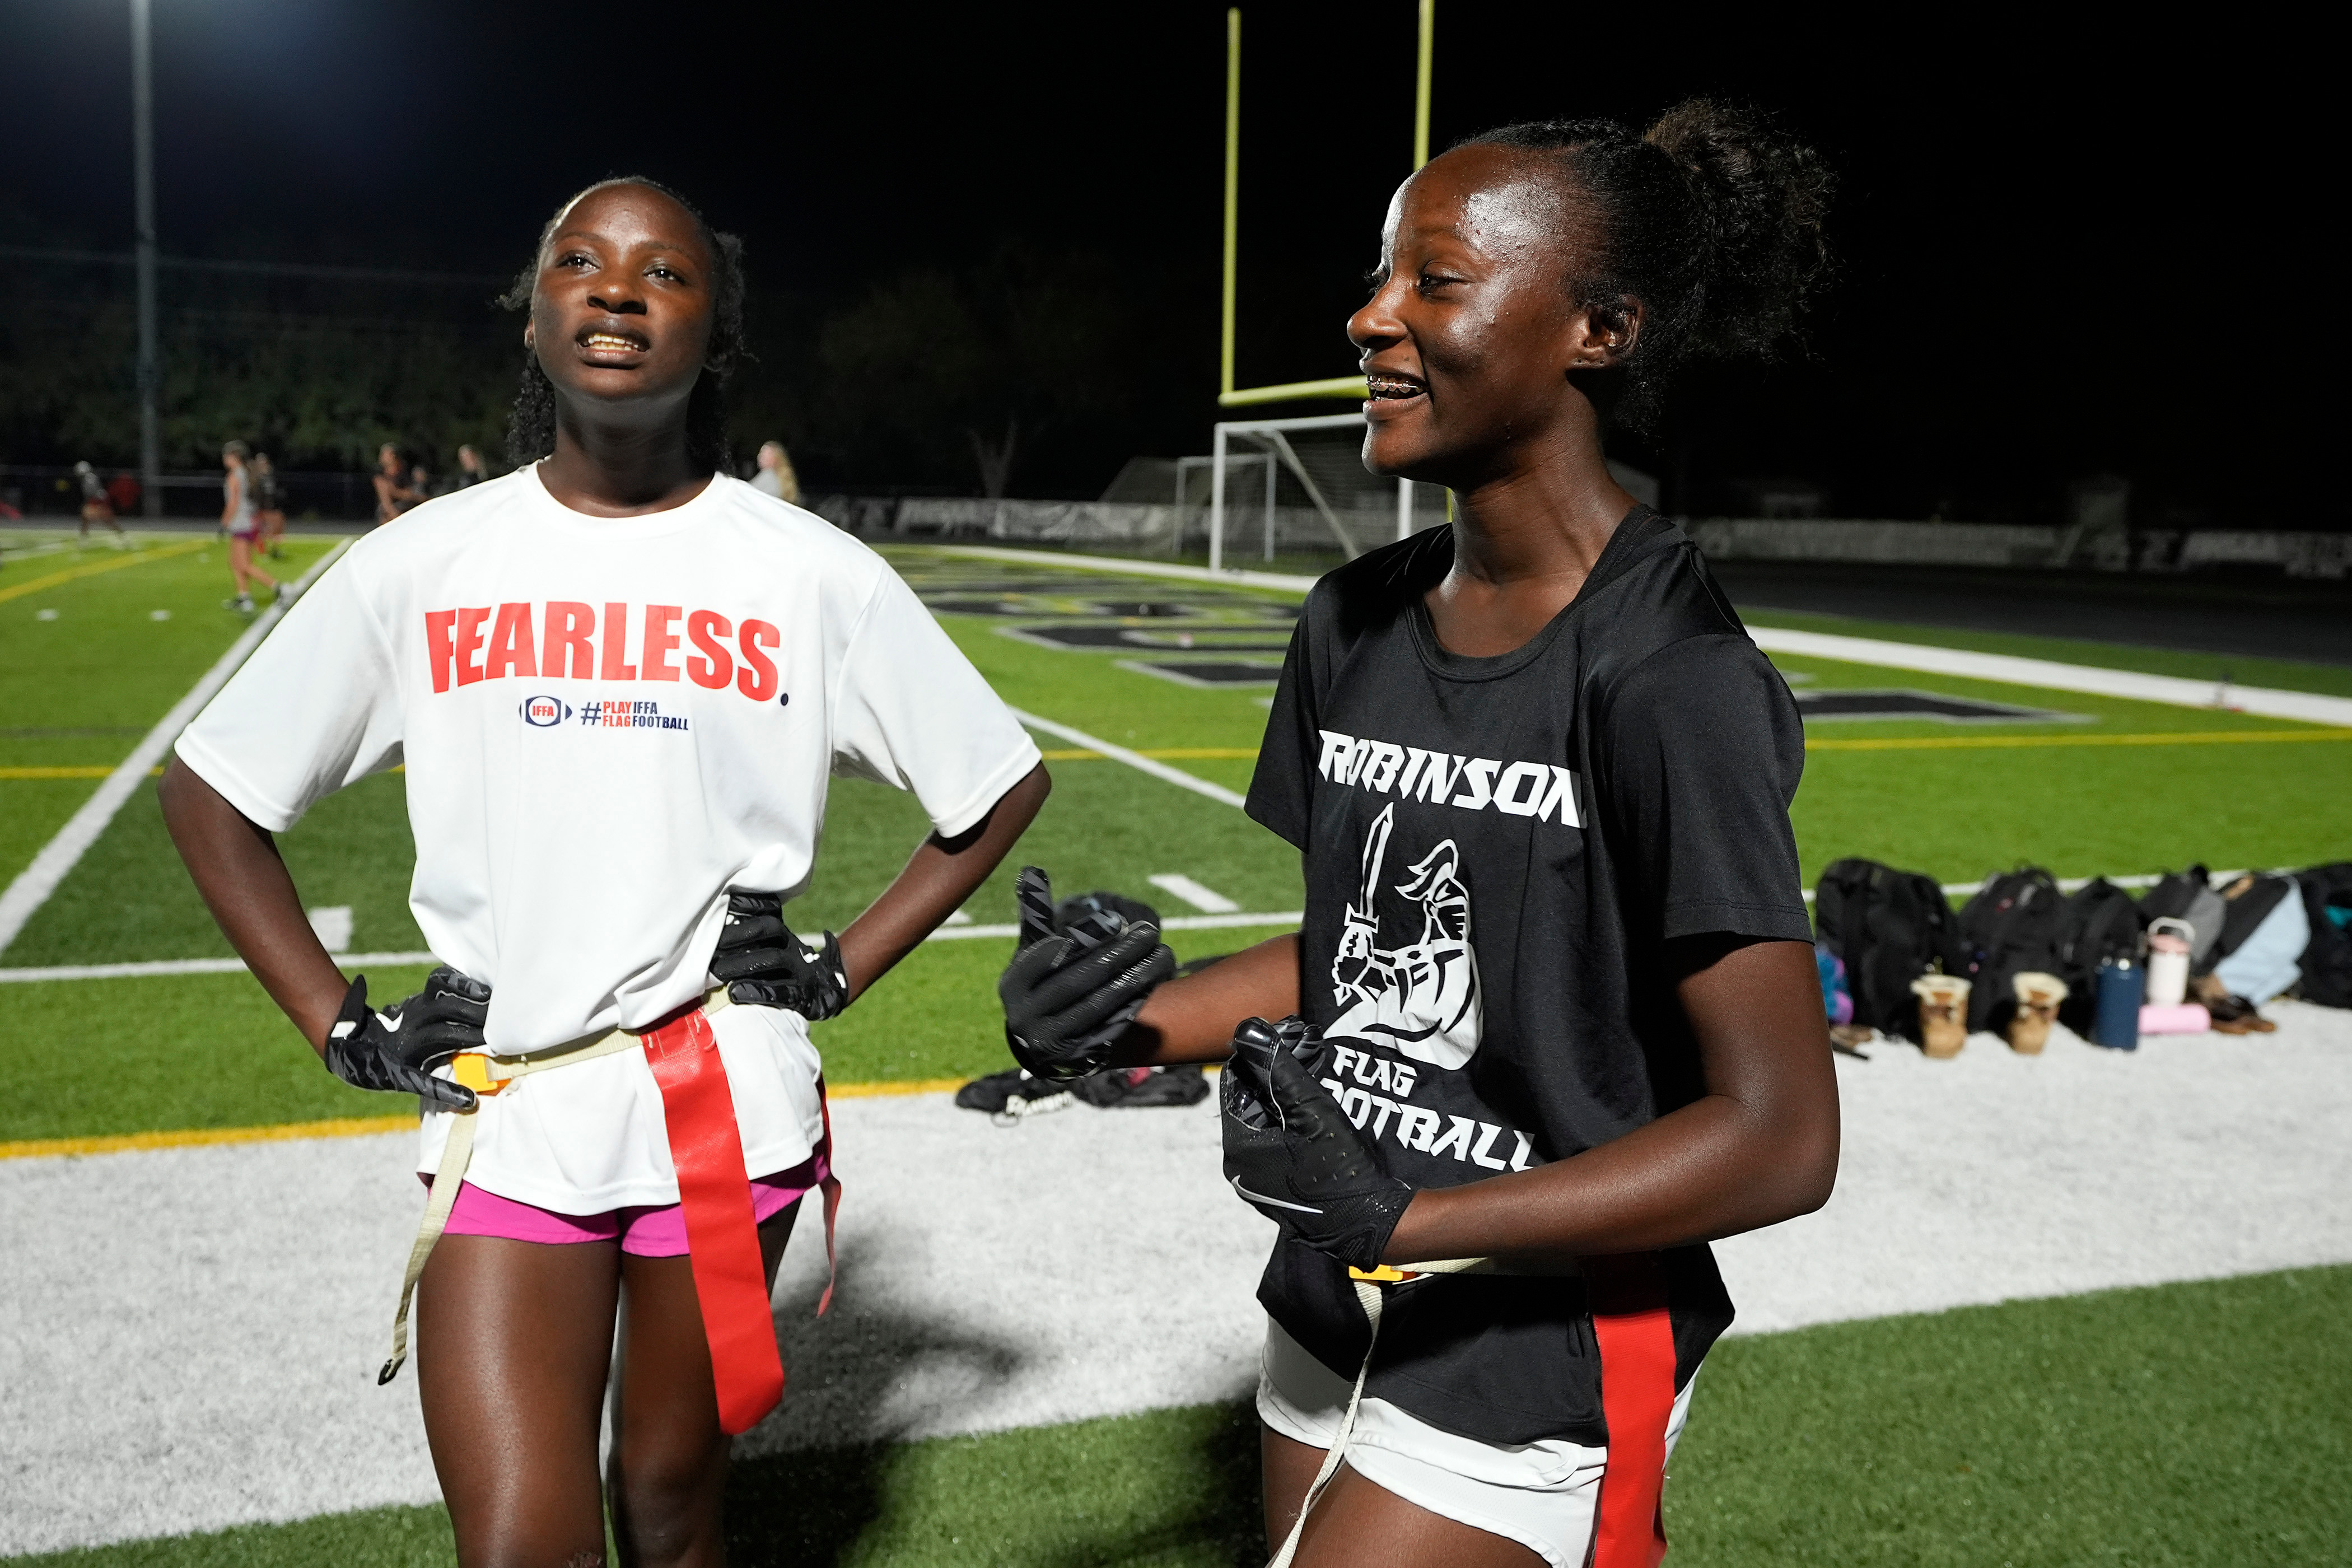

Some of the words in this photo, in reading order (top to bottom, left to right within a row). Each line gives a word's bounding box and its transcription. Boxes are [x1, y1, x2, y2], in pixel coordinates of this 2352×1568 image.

[425, 601, 789, 706] FEARLESS.
[532, 705, 554, 717] IFFA
[1332, 1044, 1418, 1098] FLAG
